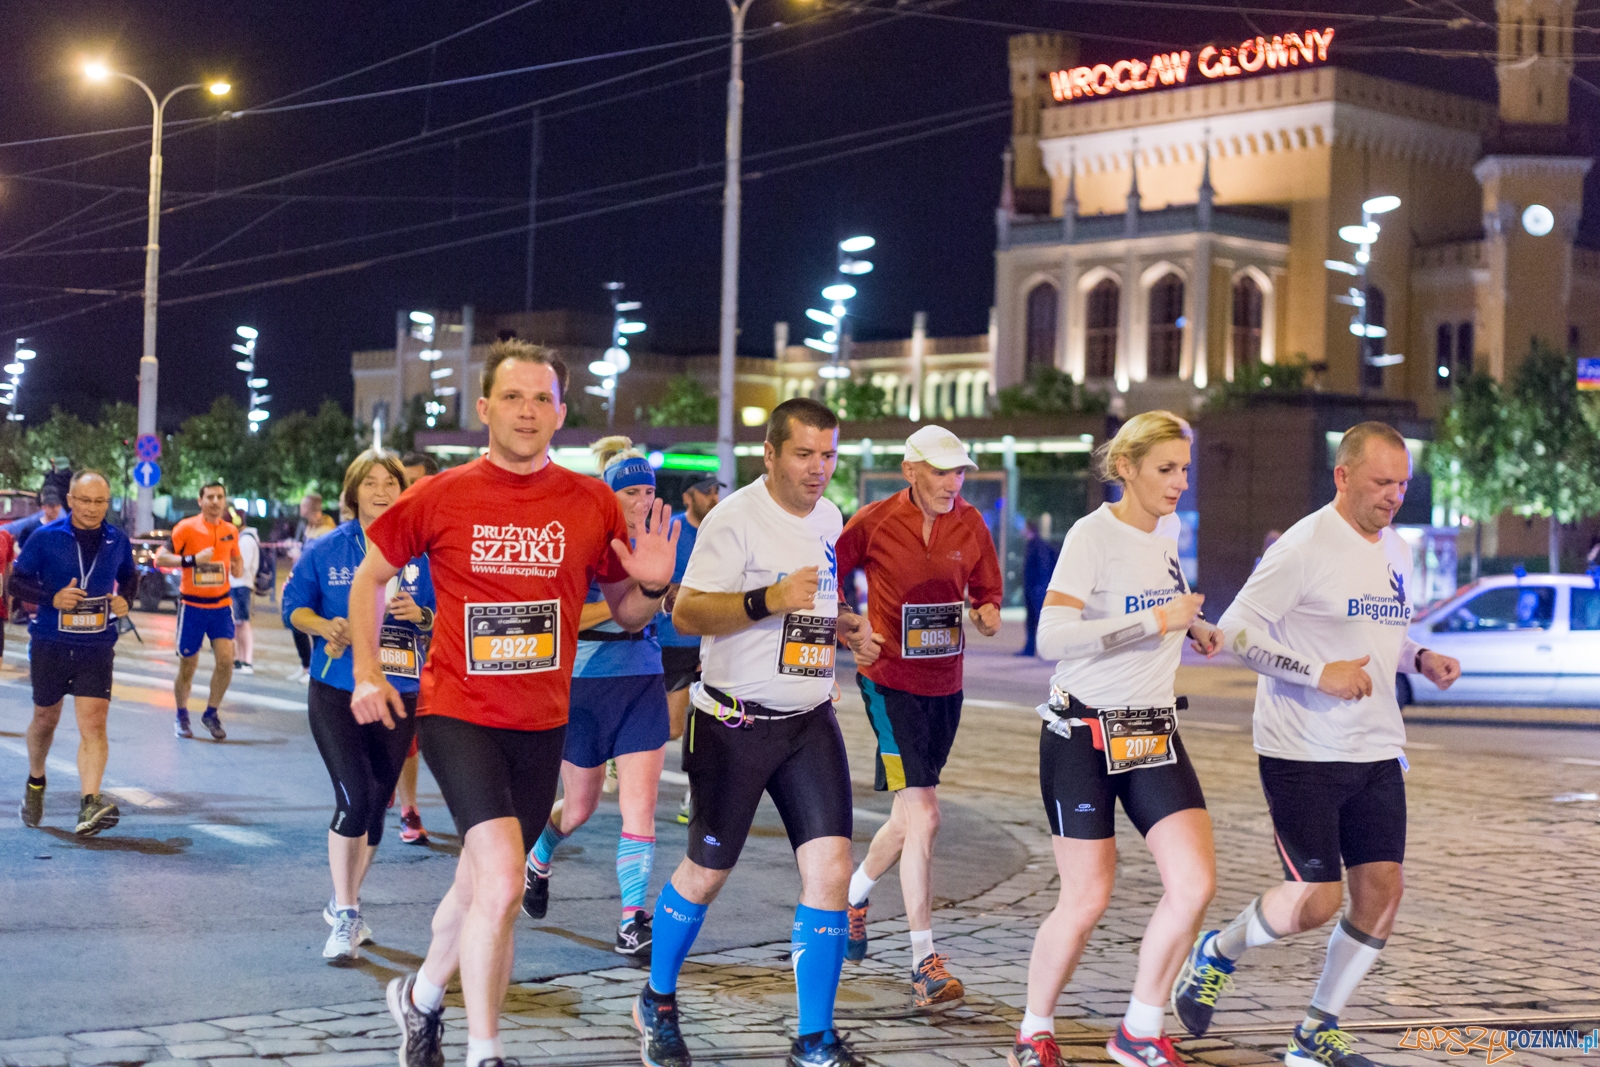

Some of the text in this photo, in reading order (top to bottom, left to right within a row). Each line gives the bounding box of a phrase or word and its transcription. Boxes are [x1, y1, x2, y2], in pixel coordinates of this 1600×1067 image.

[1050, 50, 1190, 101] WROCŁAW
[472, 523, 550, 541] DRUŻYNA
[471, 541, 566, 563] SZPIKU
[471, 564, 557, 578] www.darszpiku.pl
[1347, 598, 1411, 620] Bieganie
[72, 614, 97, 626] 8910
[490, 636, 538, 659] 2922
[921, 629, 951, 647] 9058
[799, 645, 832, 666] 3340
[642, 854, 652, 874] RUN
